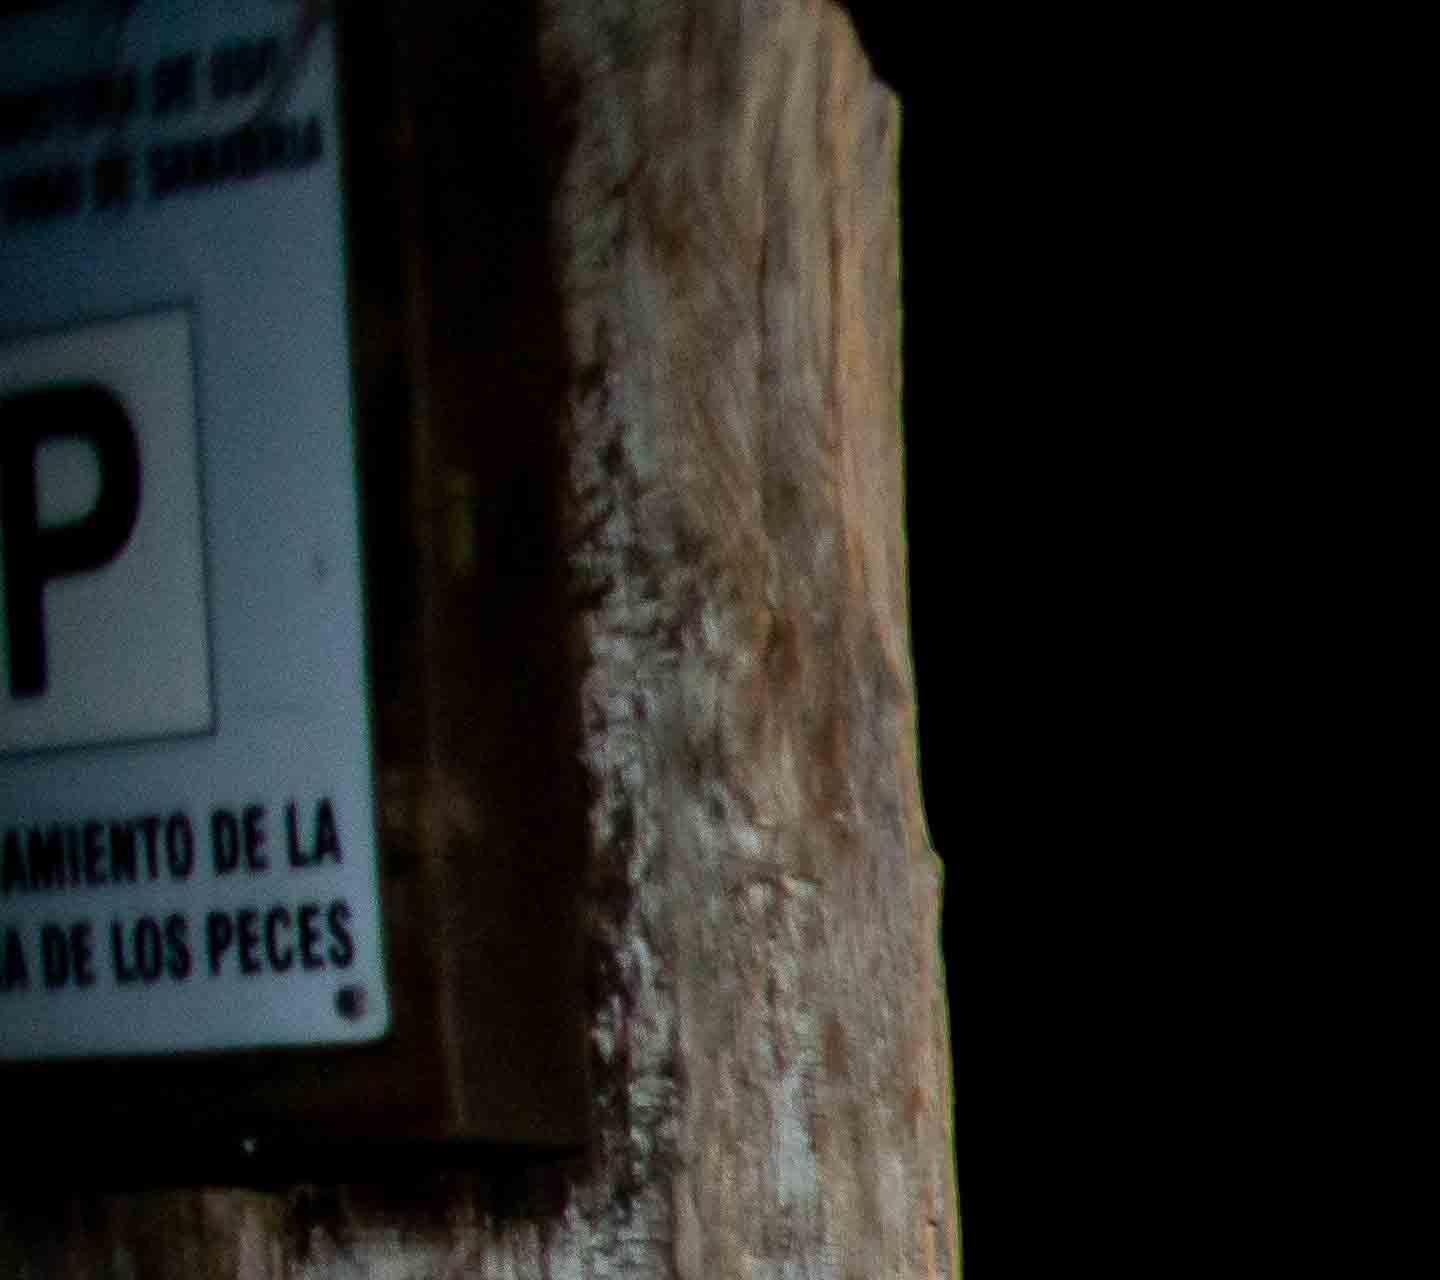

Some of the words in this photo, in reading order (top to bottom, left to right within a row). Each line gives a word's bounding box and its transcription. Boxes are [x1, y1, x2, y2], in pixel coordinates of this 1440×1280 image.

[2, 382, 140, 697] P
[211, 803, 268, 878] DE
[287, 797, 343, 872] LA
[42, 919, 96, 990] DE
[112, 910, 192, 985] LOS
[206, 897, 355, 978] PECES
